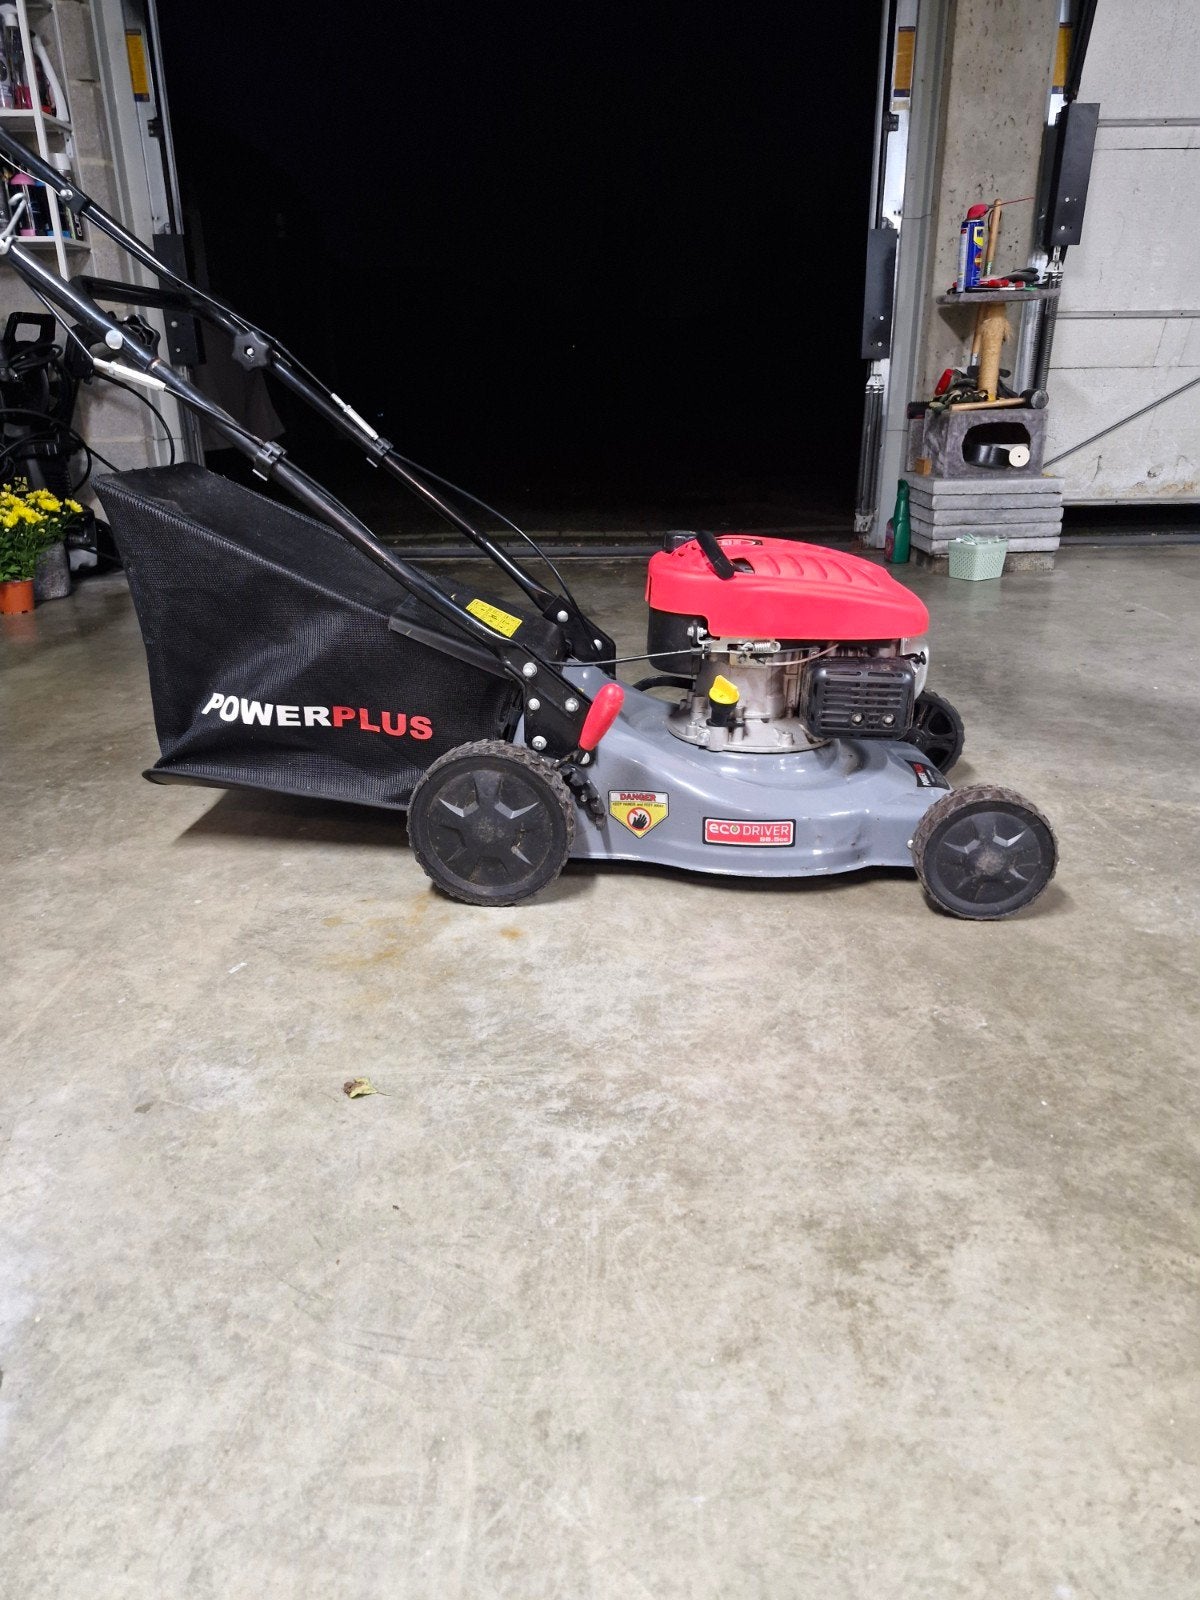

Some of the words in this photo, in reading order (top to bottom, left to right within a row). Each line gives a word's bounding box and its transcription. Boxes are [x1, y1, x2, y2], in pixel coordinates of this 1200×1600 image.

[201, 692, 433, 740] POWERPLUS
[620, 793, 656, 801] DANGER
[709, 823, 740, 835] eco
[742, 825, 789, 836] DRIVER
